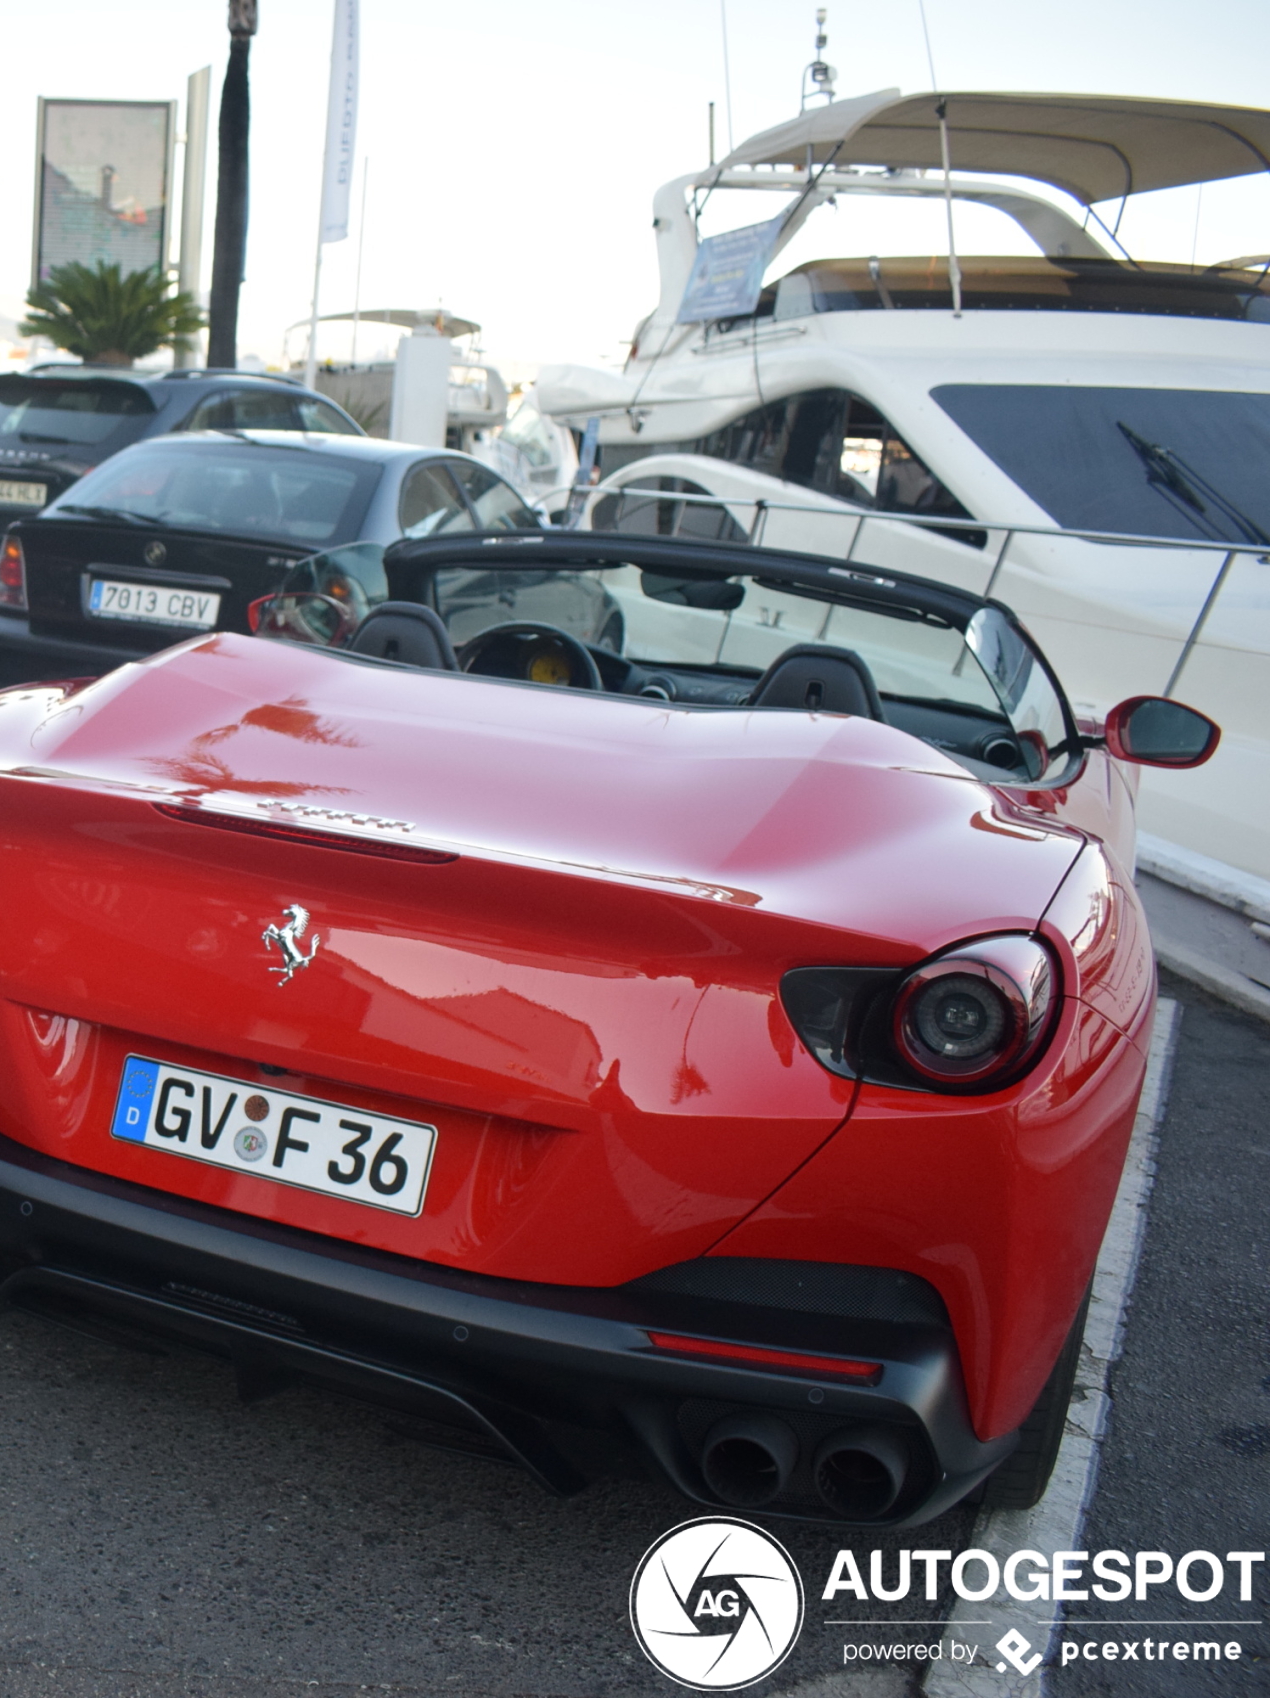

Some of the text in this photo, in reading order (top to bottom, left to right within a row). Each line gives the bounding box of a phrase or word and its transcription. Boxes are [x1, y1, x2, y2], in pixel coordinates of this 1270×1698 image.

[104, 586, 210, 619] 7013 CBV
[126, 1106, 140, 1125] D
[154, 1077, 409, 1195] GV F 36
